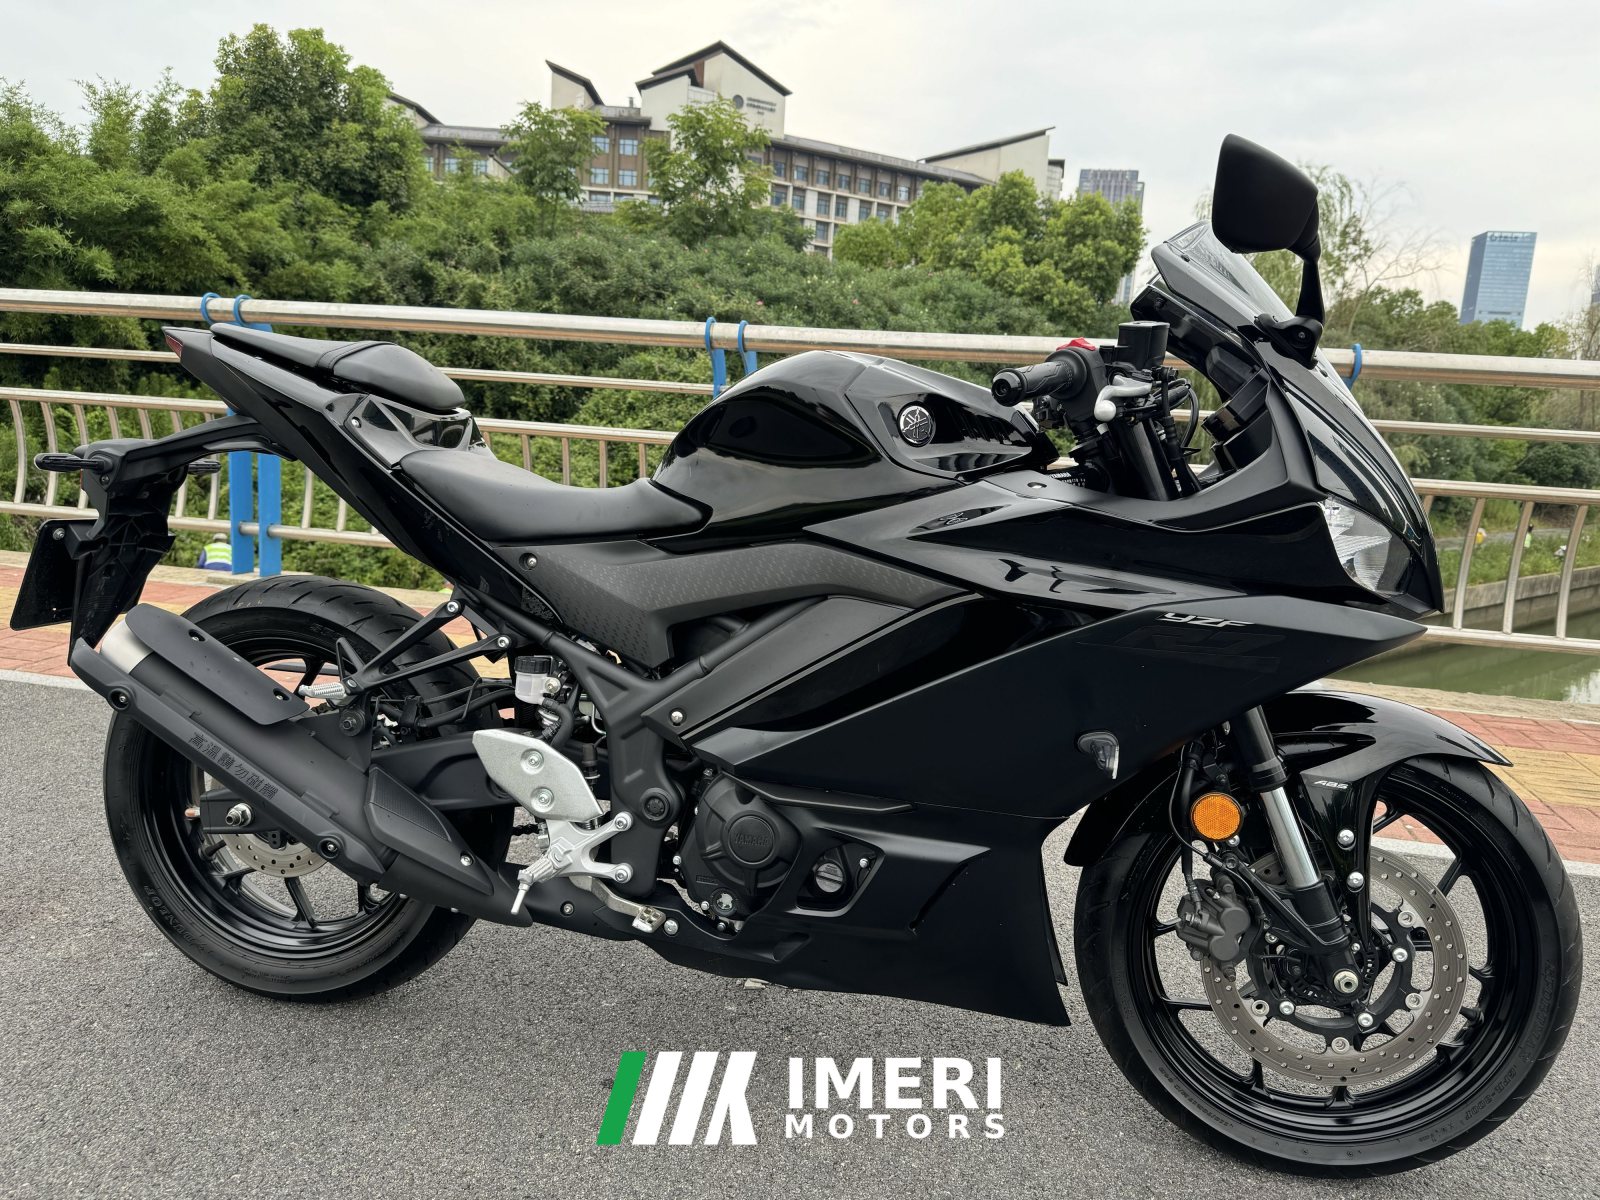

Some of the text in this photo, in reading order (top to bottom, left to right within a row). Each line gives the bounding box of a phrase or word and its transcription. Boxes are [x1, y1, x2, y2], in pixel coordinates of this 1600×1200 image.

[1157, 612, 1255, 628] YZF
[735, 833, 769, 847] YAMAHA
[143, 885, 194, 946] DUNLOP
